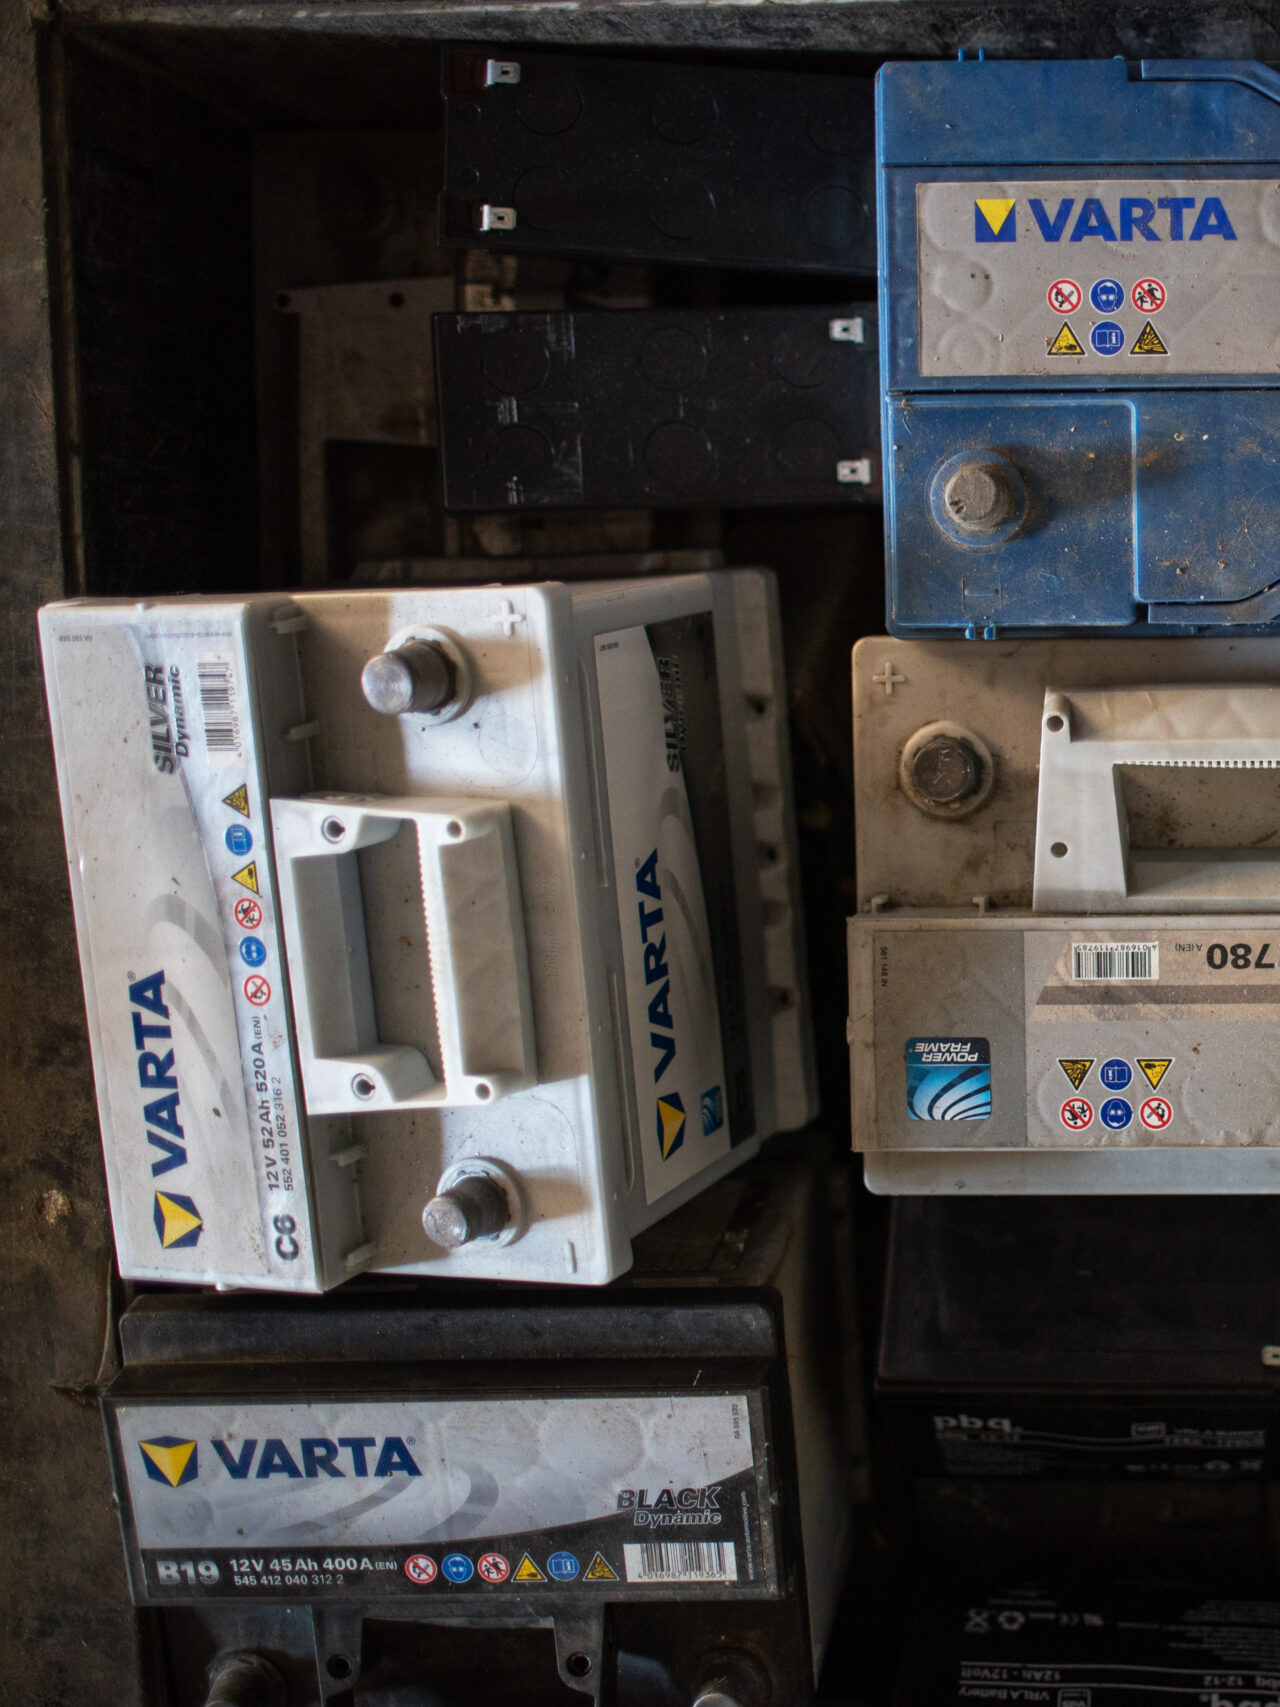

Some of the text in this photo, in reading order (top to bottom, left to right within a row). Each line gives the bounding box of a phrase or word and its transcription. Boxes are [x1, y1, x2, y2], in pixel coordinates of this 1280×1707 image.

[1027, 196, 1238, 242] VARTA
[144, 662, 178, 776] SILVER
[168, 664, 191, 759] Dynamic
[657, 656, 681, 773] SILVER
[635, 847, 677, 1085] VARTA
[1206, 942, 1276, 970] 780
[914, 1042, 972, 1054] FRAME
[921, 1052, 980, 1064] POWER
[128, 969, 189, 1178] VARTA
[277, 1114, 290, 1139] 052
[280, 1140, 293, 1165] 401
[283, 1168, 295, 1192] 552
[274, 1213, 300, 1262] C6
[932, 1413, 1014, 1433] pbq
[210, 1436, 423, 1480] VARTA
[615, 1486, 722, 1510] BLACK
[633, 1510, 722, 1529] Dynamic
[156, 1560, 221, 1586] B19
[229, 1558, 265, 1573] 12V
[234, 1574, 345, 1587] 545 412 040 312 2
